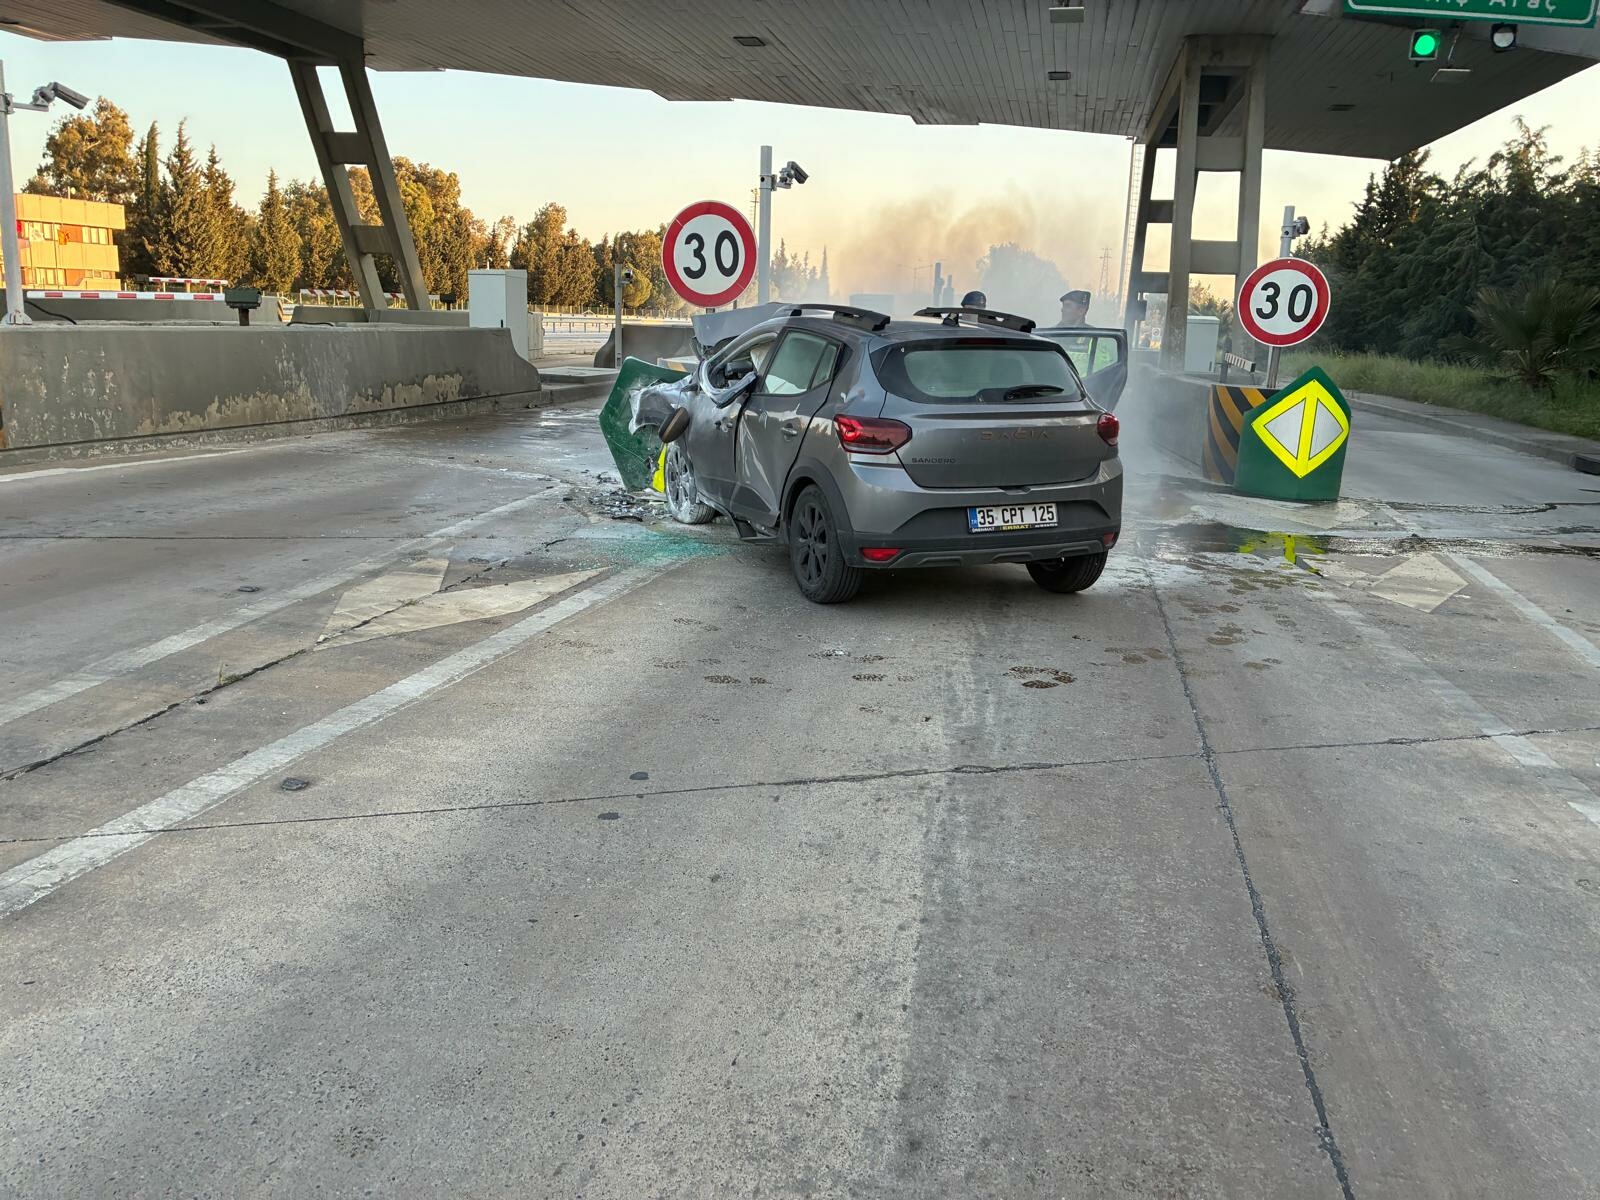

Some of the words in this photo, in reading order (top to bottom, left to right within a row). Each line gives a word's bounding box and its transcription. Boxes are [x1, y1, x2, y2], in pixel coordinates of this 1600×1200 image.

[683, 230, 739, 279] 30
[1256, 282, 1313, 323] 30
[978, 509, 995, 526] 35
[1001, 507, 1025, 524] CPT
[1032, 505, 1055, 522] 125
